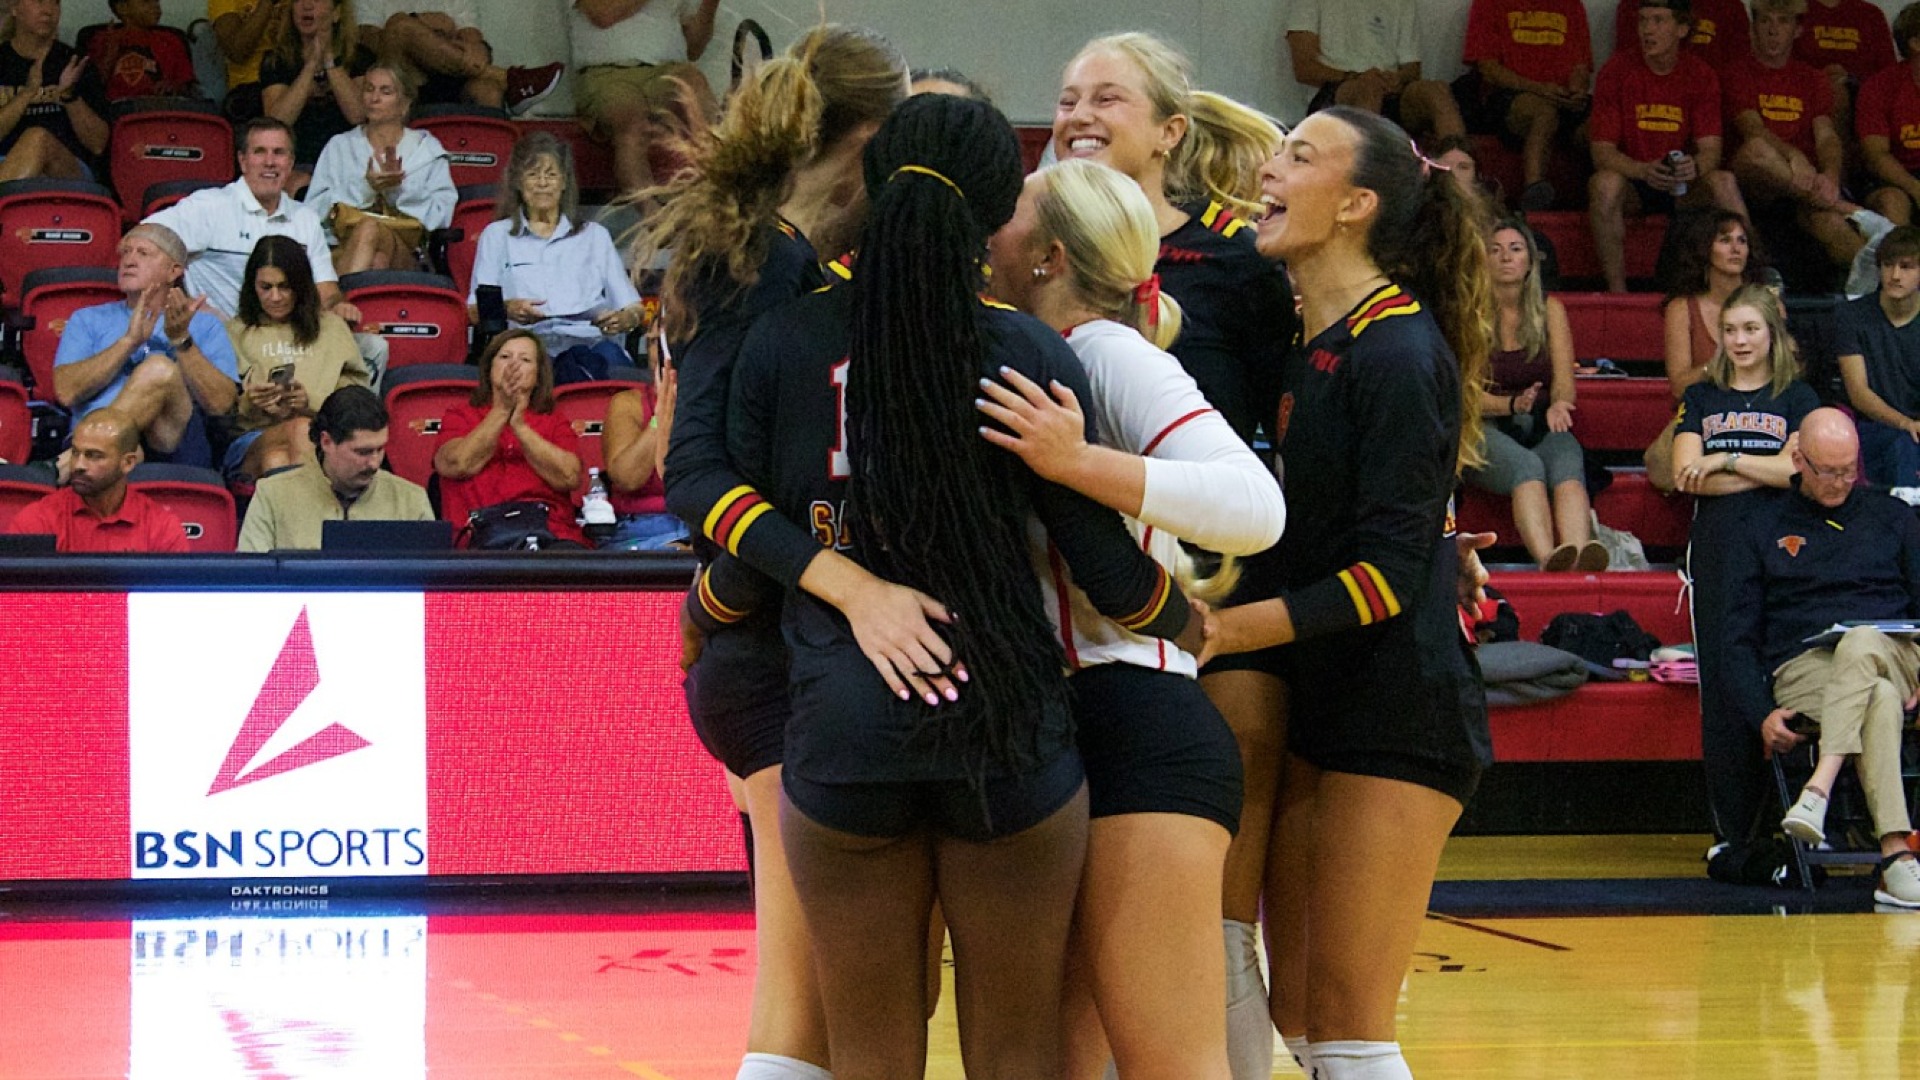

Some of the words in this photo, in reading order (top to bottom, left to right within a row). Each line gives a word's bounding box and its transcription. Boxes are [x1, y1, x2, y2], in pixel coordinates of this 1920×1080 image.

[1702, 411, 1787, 441] FLAGLER
[136, 830, 243, 869] BSN
[255, 828, 424, 868] SPORTS
[231, 885, 328, 897] DAKTRONICS
